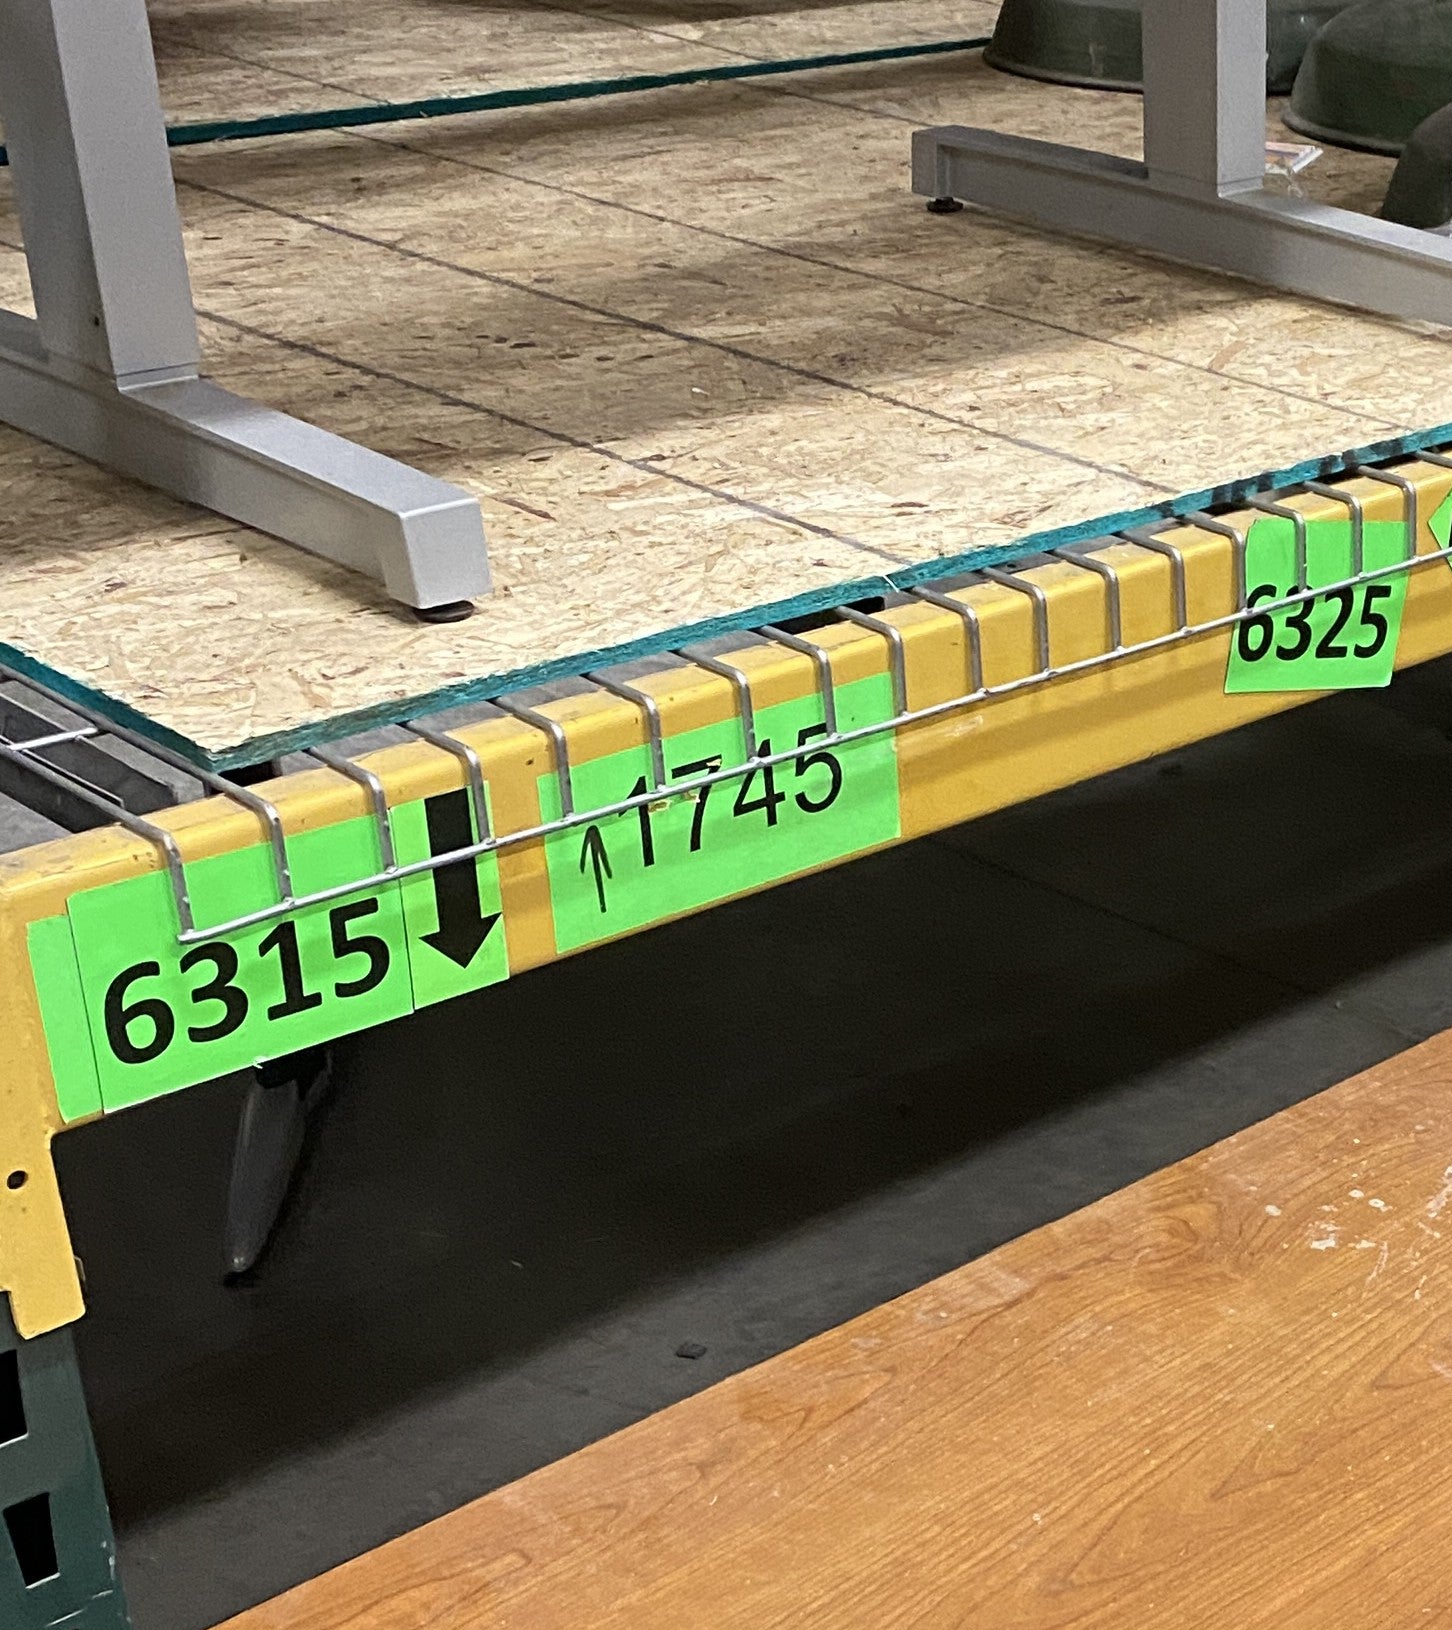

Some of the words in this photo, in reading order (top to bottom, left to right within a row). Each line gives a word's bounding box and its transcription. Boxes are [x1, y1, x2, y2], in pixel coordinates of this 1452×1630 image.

[1238, 584, 1392, 662] 6325
[618, 722, 843, 867] 1745
[104, 897, 391, 1064] 6315
